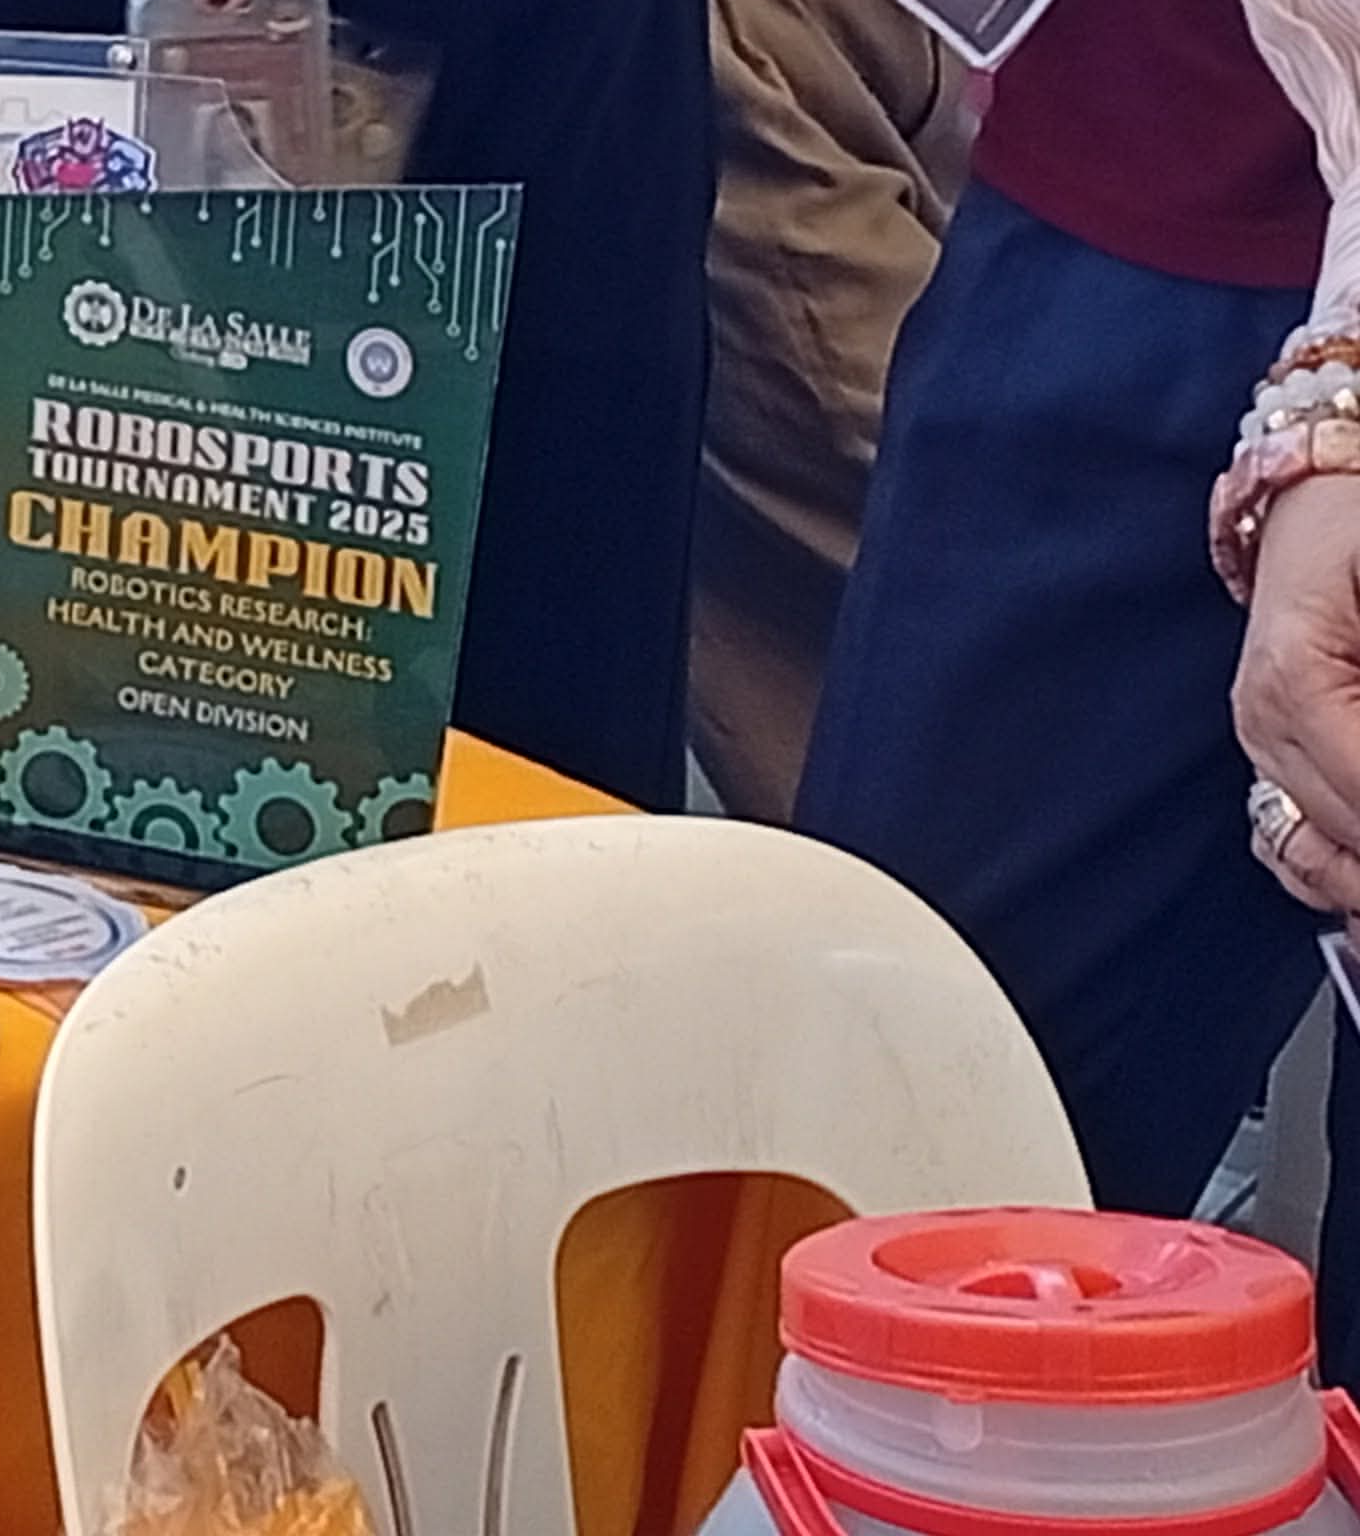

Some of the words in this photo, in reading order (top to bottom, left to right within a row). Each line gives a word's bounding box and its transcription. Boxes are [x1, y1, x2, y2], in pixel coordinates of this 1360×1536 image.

[228, 312, 311, 348] SALLE
[31, 397, 429, 508] ROBOSPORTS
[27, 446, 317, 526] TOURNAMENT
[329, 498, 430, 546] 2025
[8, 489, 437, 620] CHAMPION
[70, 566, 211, 614] ROBOTICS
[47, 597, 166, 641] HEALTH
[172, 621, 234, 653] AND
[239, 631, 393, 683] WELLNESS
[139, 650, 295, 700] CATEGORY
[117, 685, 191, 721] OPEN
[195, 700, 308, 743] DIVISION
